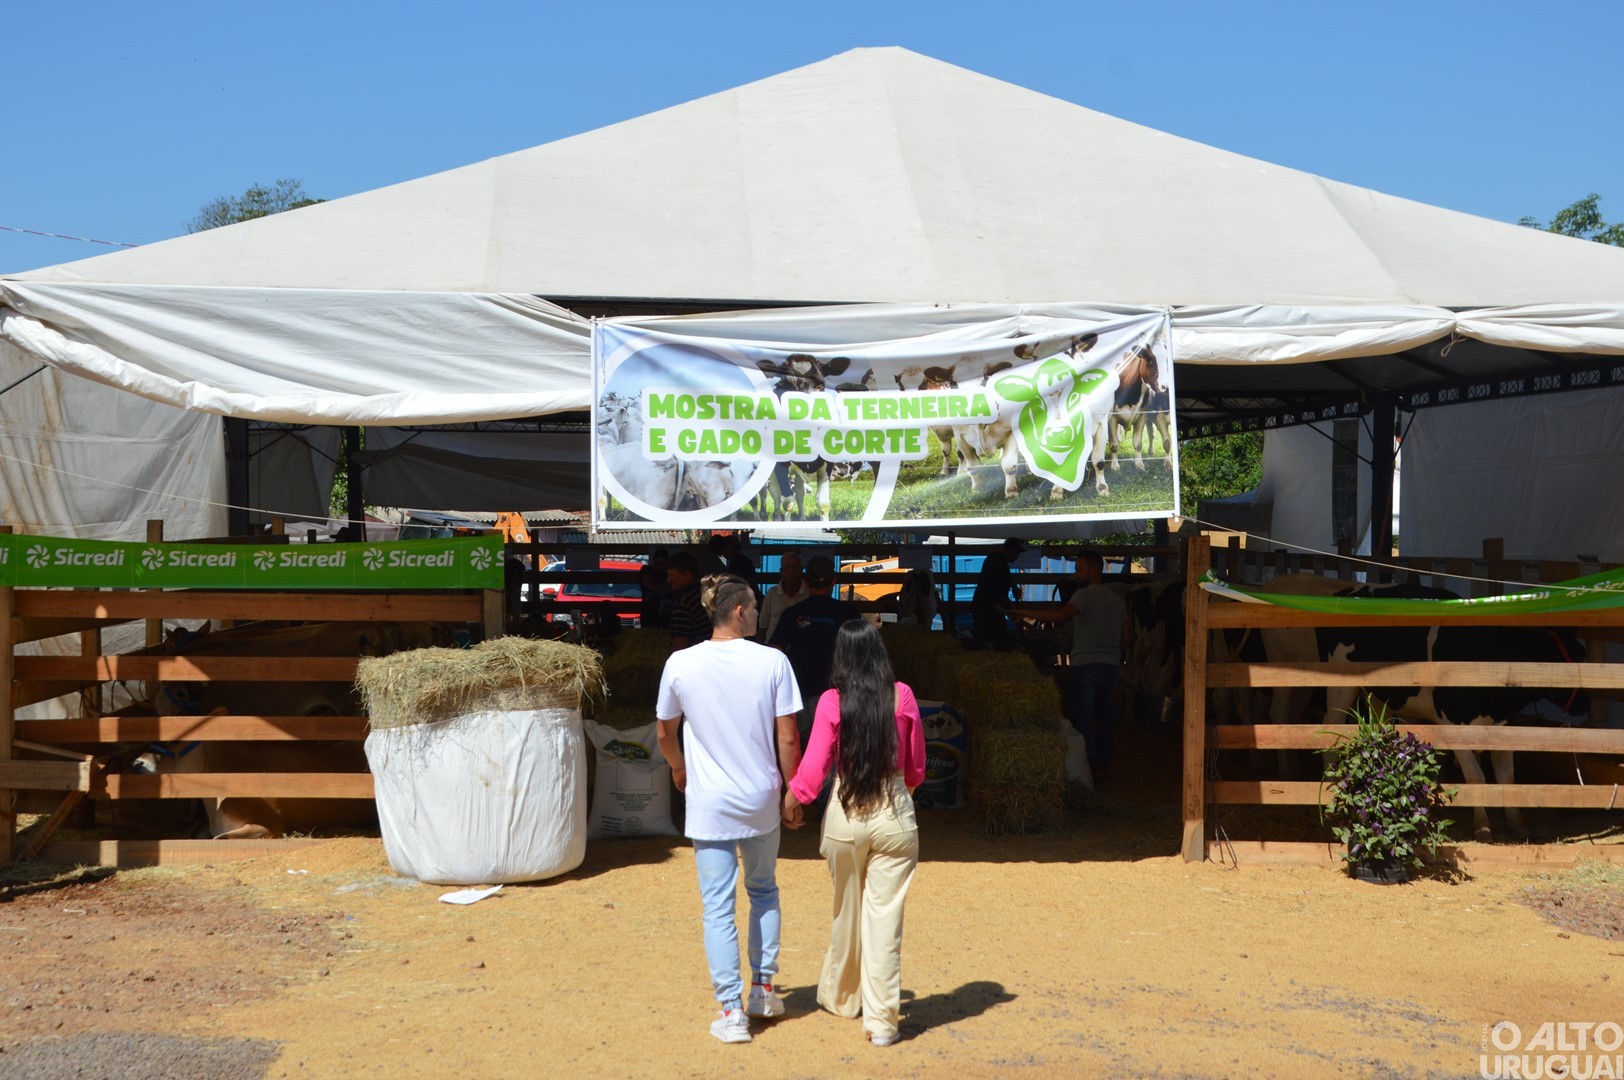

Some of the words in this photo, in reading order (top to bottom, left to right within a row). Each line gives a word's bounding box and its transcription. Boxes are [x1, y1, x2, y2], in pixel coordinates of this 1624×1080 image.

[649, 394, 777, 420] MOSTRA
[788, 398, 832, 420] DA
[843, 394, 991, 420] TERNEIRA
[649, 428, 666, 454] E
[677, 429, 762, 454] GADO
[773, 429, 811, 454] DE
[823, 428, 921, 455] CORTE
[53, 548, 125, 566] Sicredi
[168, 551, 237, 568] Sicredi
[279, 551, 347, 569] Sicredi
[388, 549, 455, 568] Sicredi
